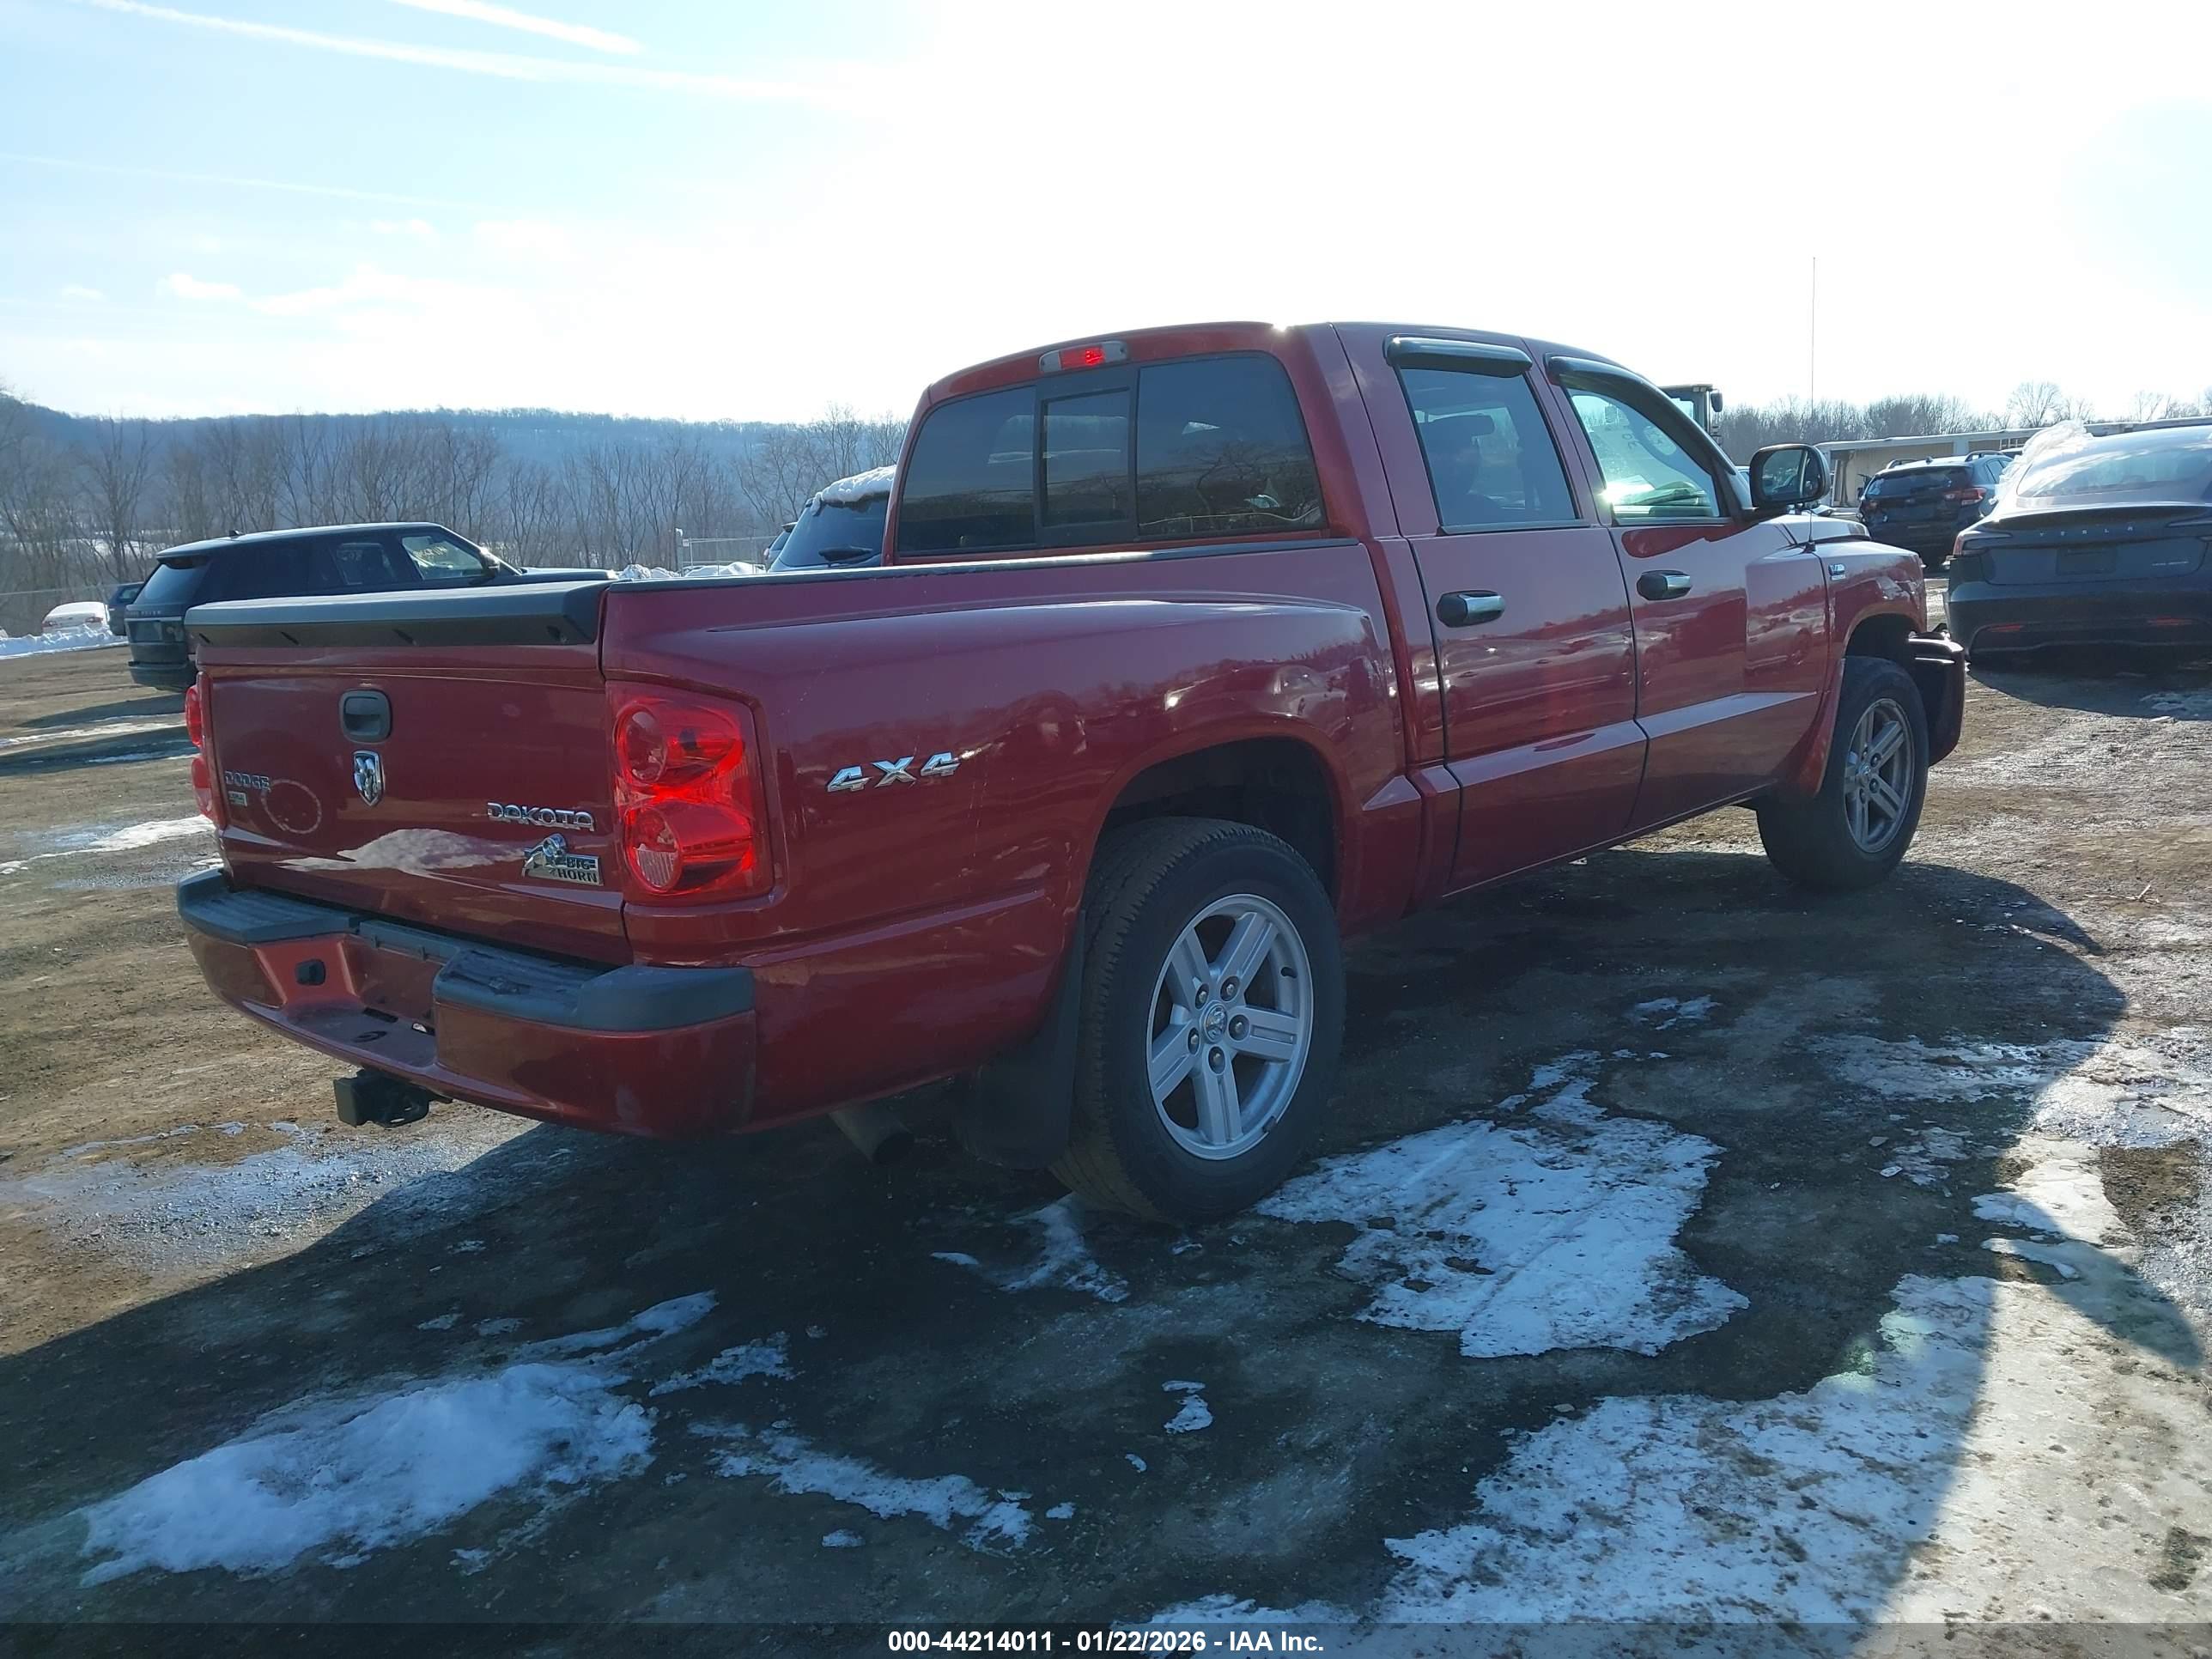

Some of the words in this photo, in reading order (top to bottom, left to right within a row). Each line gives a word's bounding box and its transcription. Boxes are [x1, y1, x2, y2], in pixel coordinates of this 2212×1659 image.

[224, 769, 271, 793] DODGE
[486, 801, 595, 832] DAKOTA
[567, 856, 597, 871] BIG
[558, 868, 598, 884] HORN
